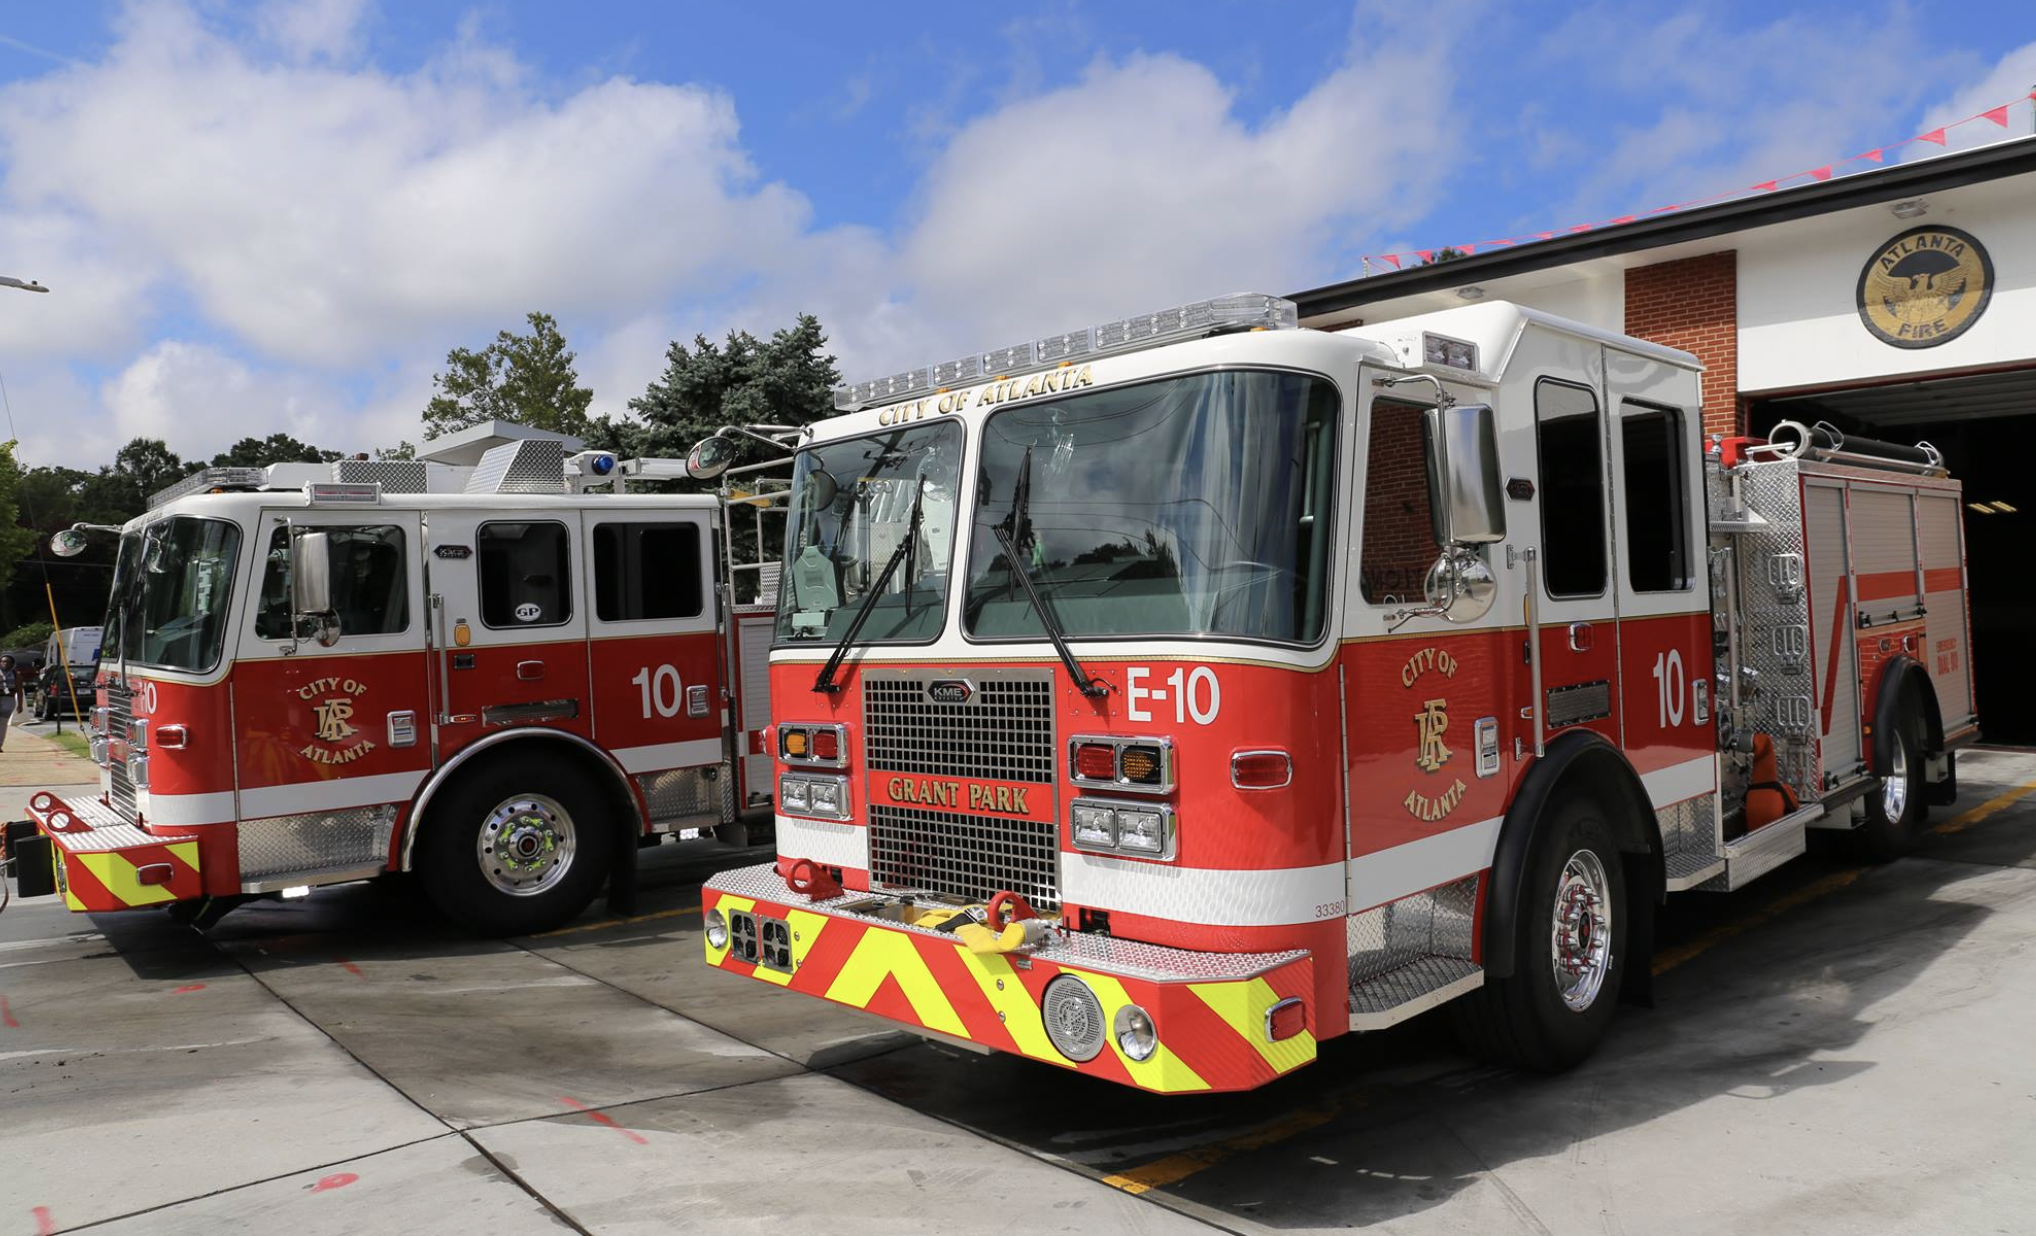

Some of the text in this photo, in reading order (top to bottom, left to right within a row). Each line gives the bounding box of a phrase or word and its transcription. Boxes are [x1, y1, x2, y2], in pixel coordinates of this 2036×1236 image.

[1881, 235, 1965, 270] ATLANTA
[1896, 319, 1949, 338] FIRE
[879, 365, 1094, 426] CITY OF ATLANTA
[517, 607, 539, 617] GP
[1402, 648, 1458, 688] CITY OF
[299, 677, 368, 700] CITY OF
[632, 664, 683, 719] 10
[934, 688, 962, 697] KME
[1127, 666, 1220, 725] E-10
[1653, 648, 1684, 729] 10
[300, 740, 377, 764] ATLANTA
[889, 777, 1030, 815] GRANT PARK
[1404, 779, 1467, 822] ATLANTA
[1315, 900, 1345, 918] 33380
